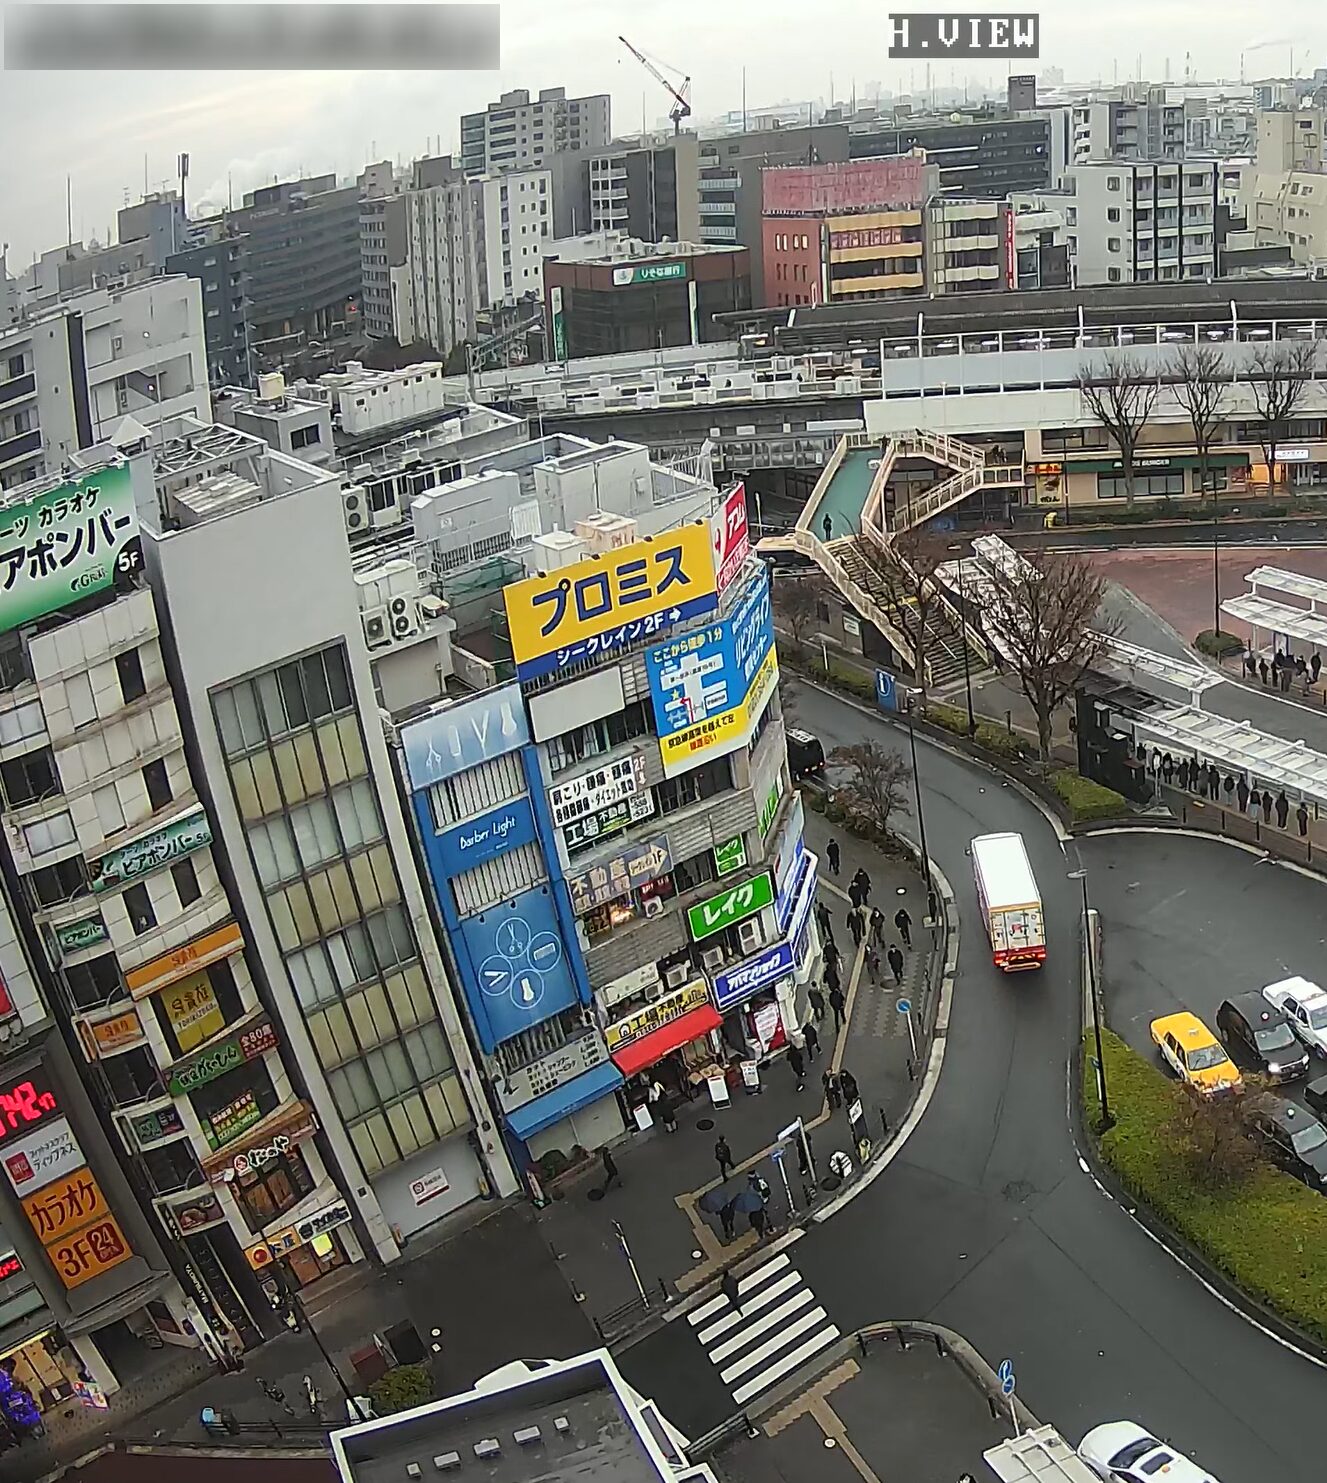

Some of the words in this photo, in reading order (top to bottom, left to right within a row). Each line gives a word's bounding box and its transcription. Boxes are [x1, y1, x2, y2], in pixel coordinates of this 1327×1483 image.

[38, 486, 100, 528] カラオケ
[118, 551, 139, 572] 5F
[532, 545, 691, 638] プロミス
[556, 620, 642, 666] シークレイン
[645, 614, 665, 635] 2F
[459, 829, 490, 850] Barber
[492, 815, 516, 838] Light
[702, 883, 754, 927] レイク
[31, 1179, 97, 1238] カラオケ
[57, 1238, 91, 1278] 3F
[91, 1225, 115, 1250] 24
